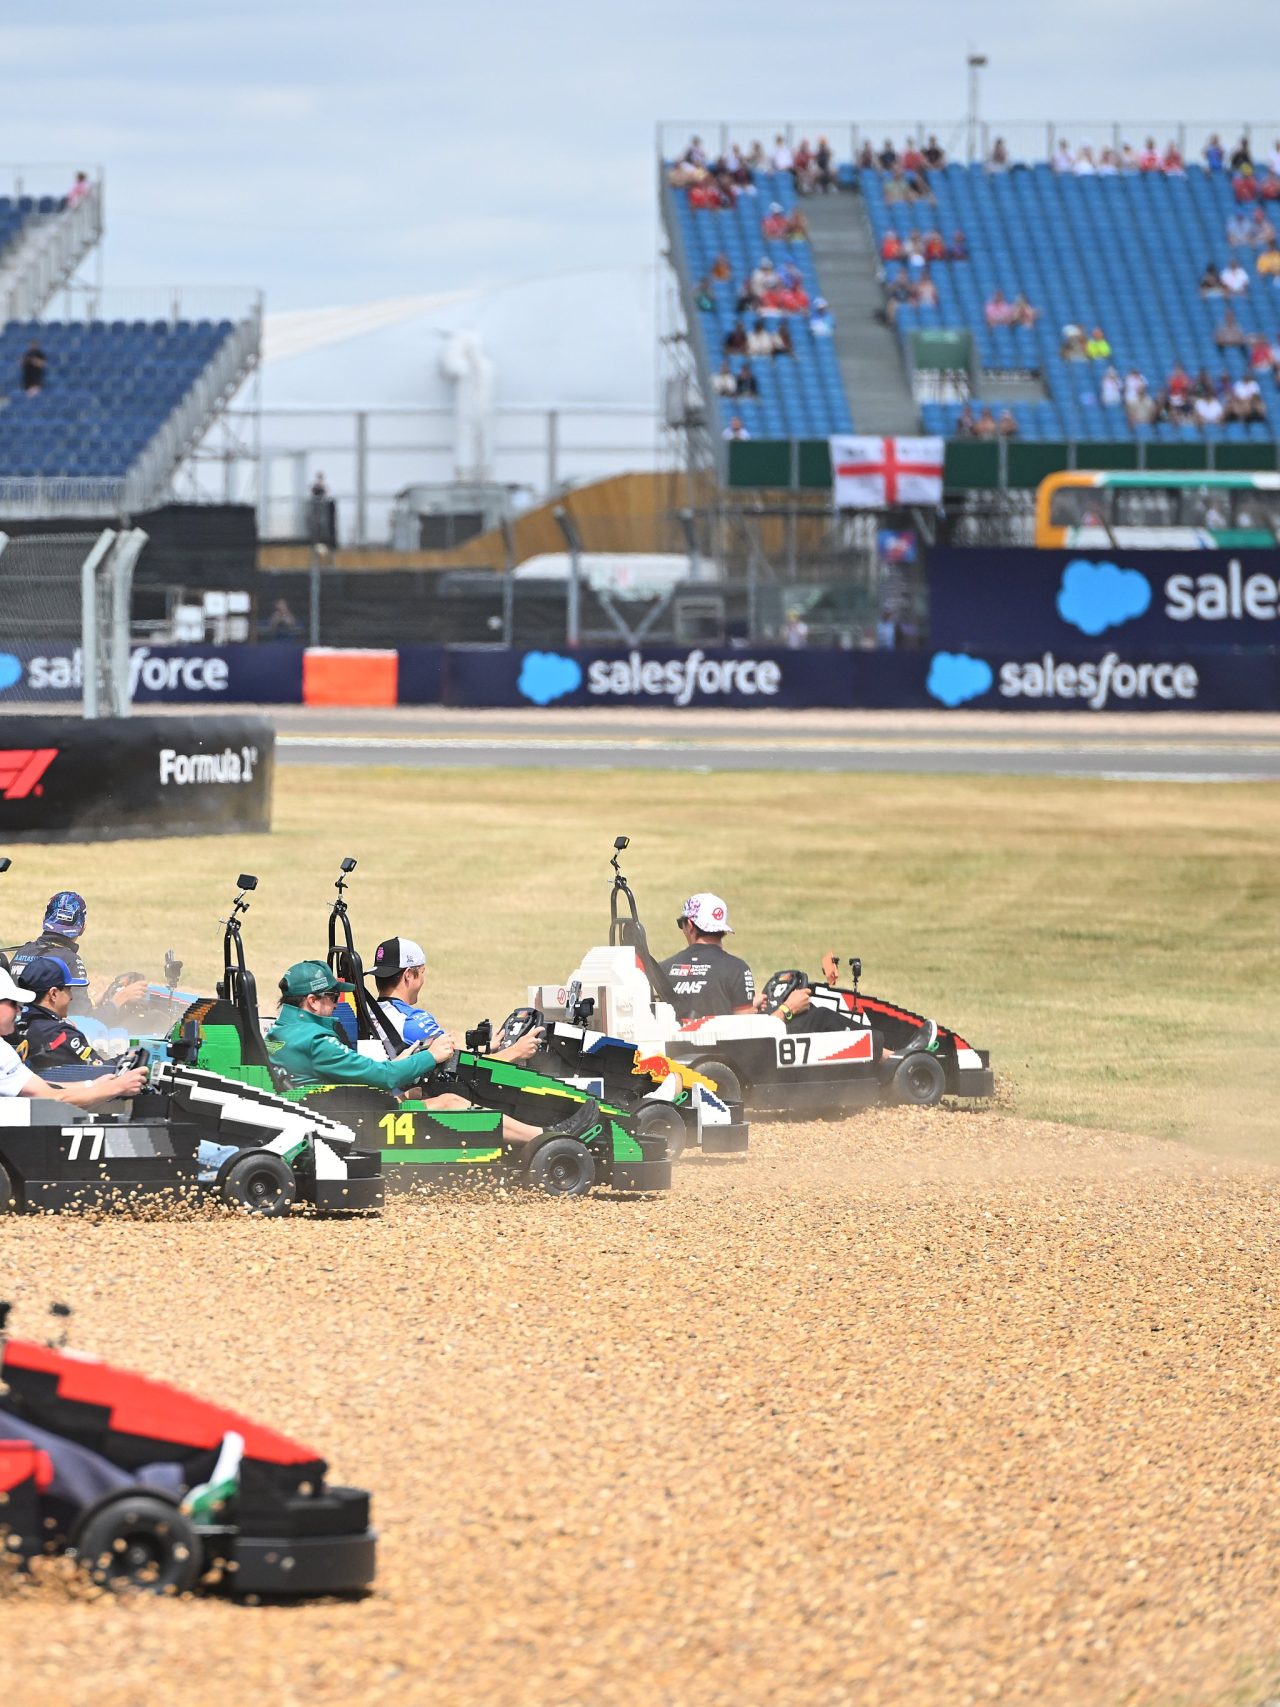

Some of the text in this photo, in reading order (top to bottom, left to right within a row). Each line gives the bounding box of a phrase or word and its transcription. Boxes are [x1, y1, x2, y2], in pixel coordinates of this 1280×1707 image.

[1164, 557, 1280, 622] sale
[28, 647, 229, 700] salforce
[587, 649, 782, 706] salesforce
[999, 651, 1199, 709] salesforce
[159, 747, 241, 785] Formula
[672, 981, 707, 994] HAAS
[779, 1037, 811, 1065] 87
[61, 1127, 105, 1161] 77
[378, 1112, 415, 1145] 14
